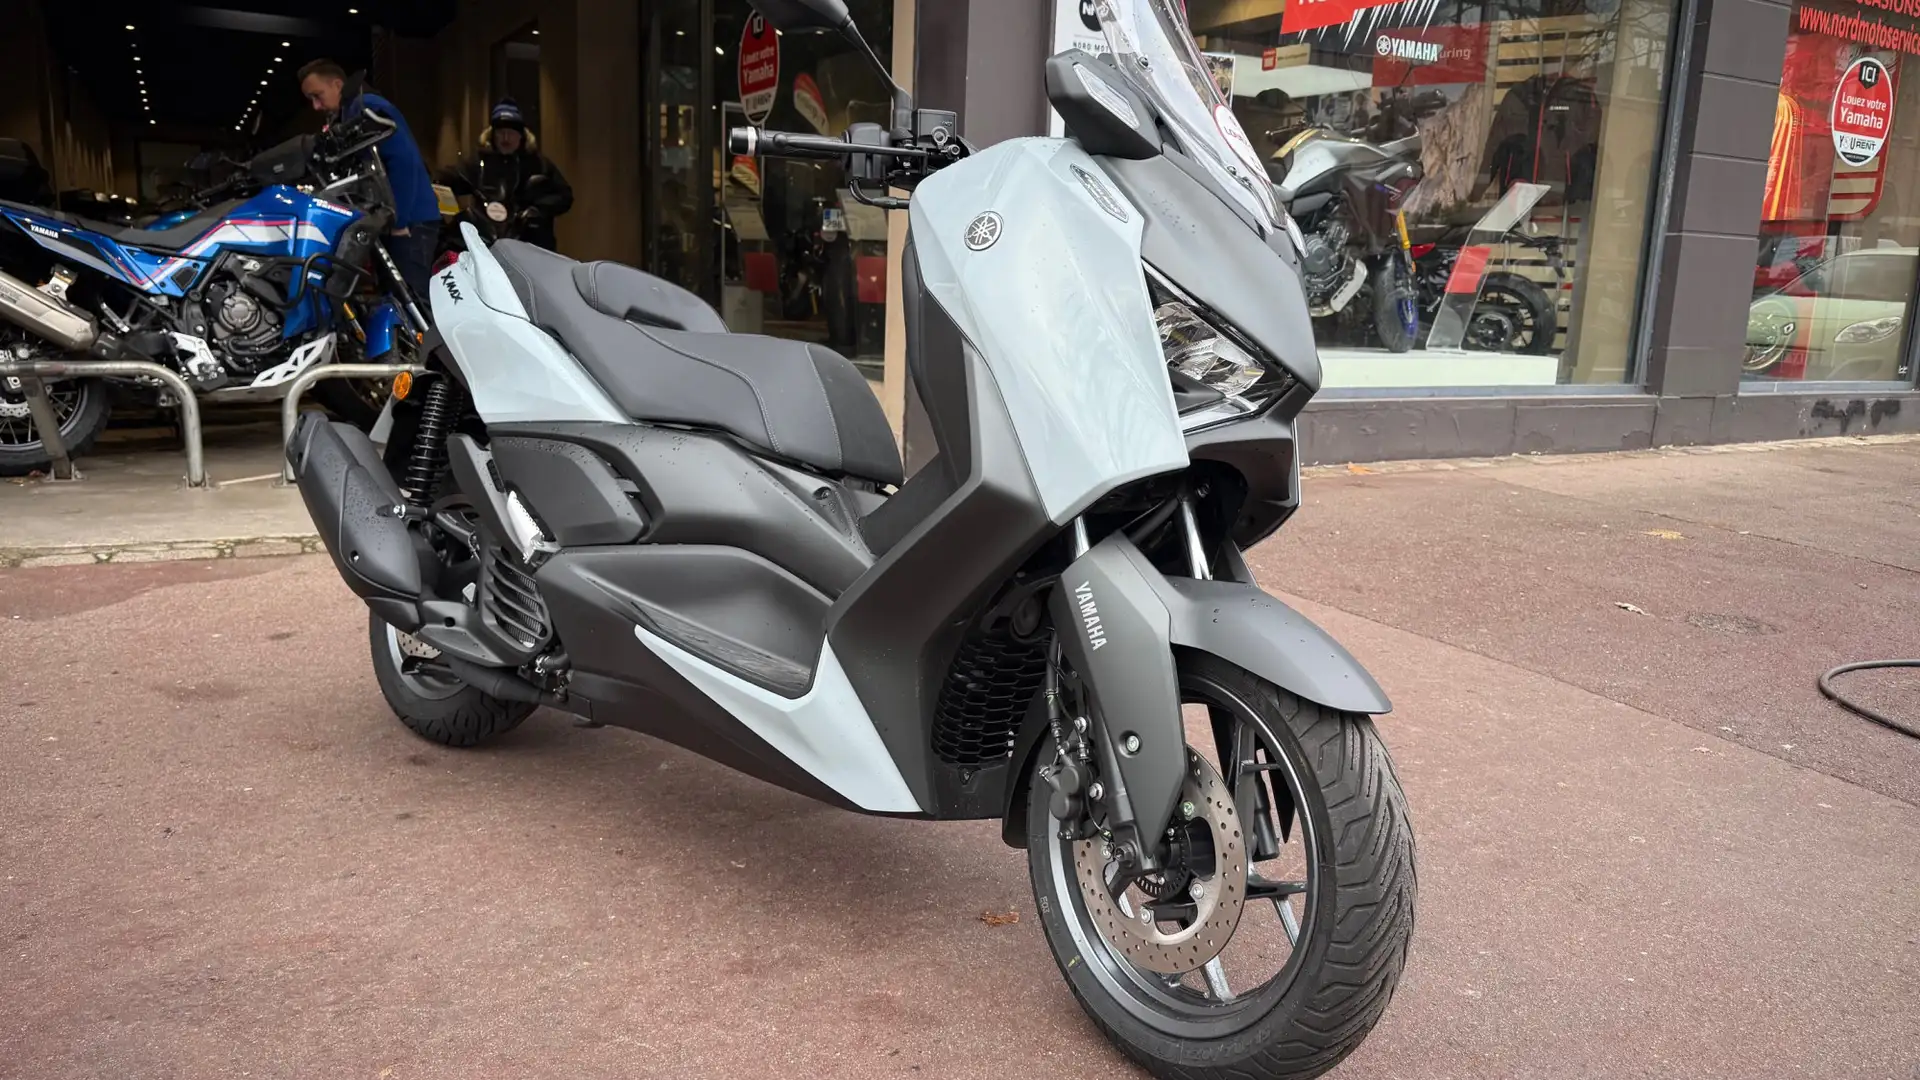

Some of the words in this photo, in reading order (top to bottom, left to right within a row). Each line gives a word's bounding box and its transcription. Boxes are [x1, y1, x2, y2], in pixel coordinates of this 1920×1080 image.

[1391, 37, 1438, 62] YAMAHA
[743, 60, 774, 86] Yamaha
[1861, 65, 1877, 83] ICI
[1841, 91, 1866, 108] Louez
[1866, 98, 1887, 111] votre
[1840, 106, 1884, 129] Yamaha
[30, 224, 59, 239] YAMAHA
[440, 270, 464, 305] XMAX
[1074, 580, 1108, 652] YAMAHA
